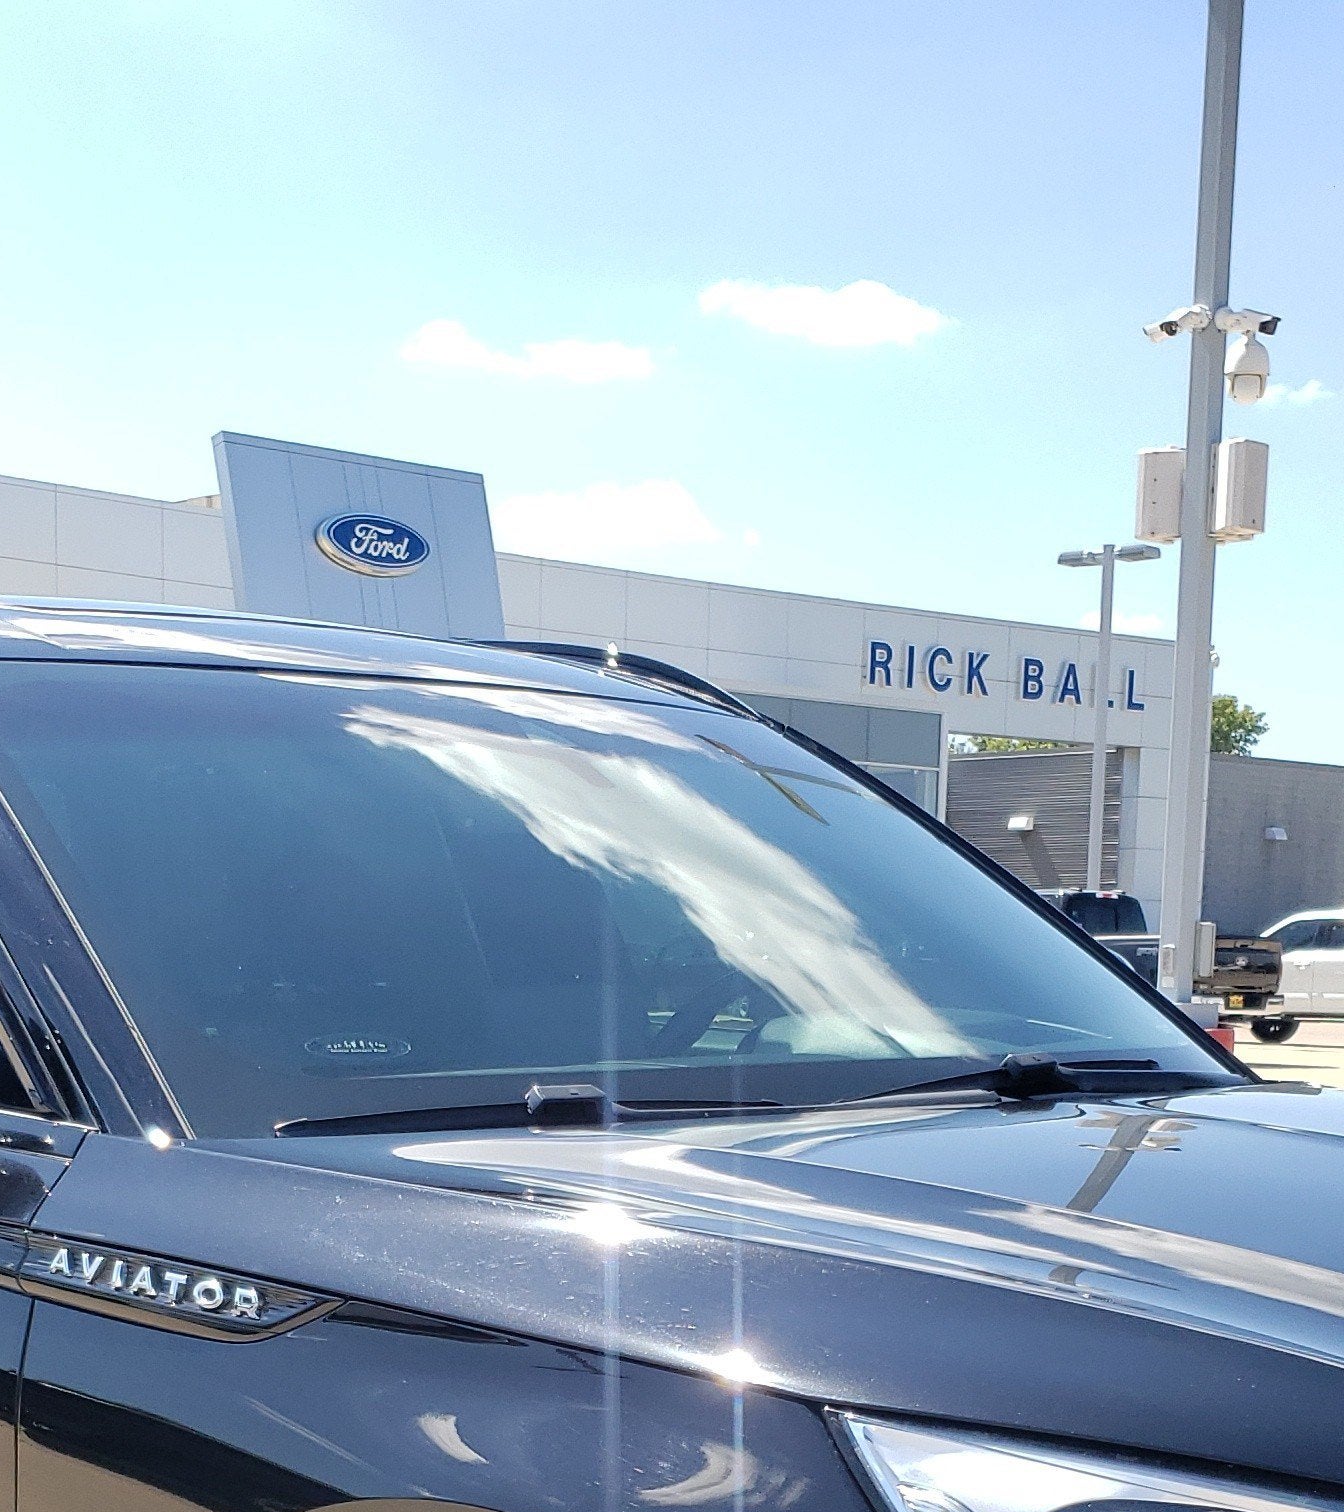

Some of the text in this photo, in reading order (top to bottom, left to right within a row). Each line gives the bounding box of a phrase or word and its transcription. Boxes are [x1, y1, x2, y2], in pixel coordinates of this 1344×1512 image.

[350, 523, 410, 560] Ford
[868, 640, 1146, 712] RICK BAL
[49, 1248, 260, 1320] AVIATOR
